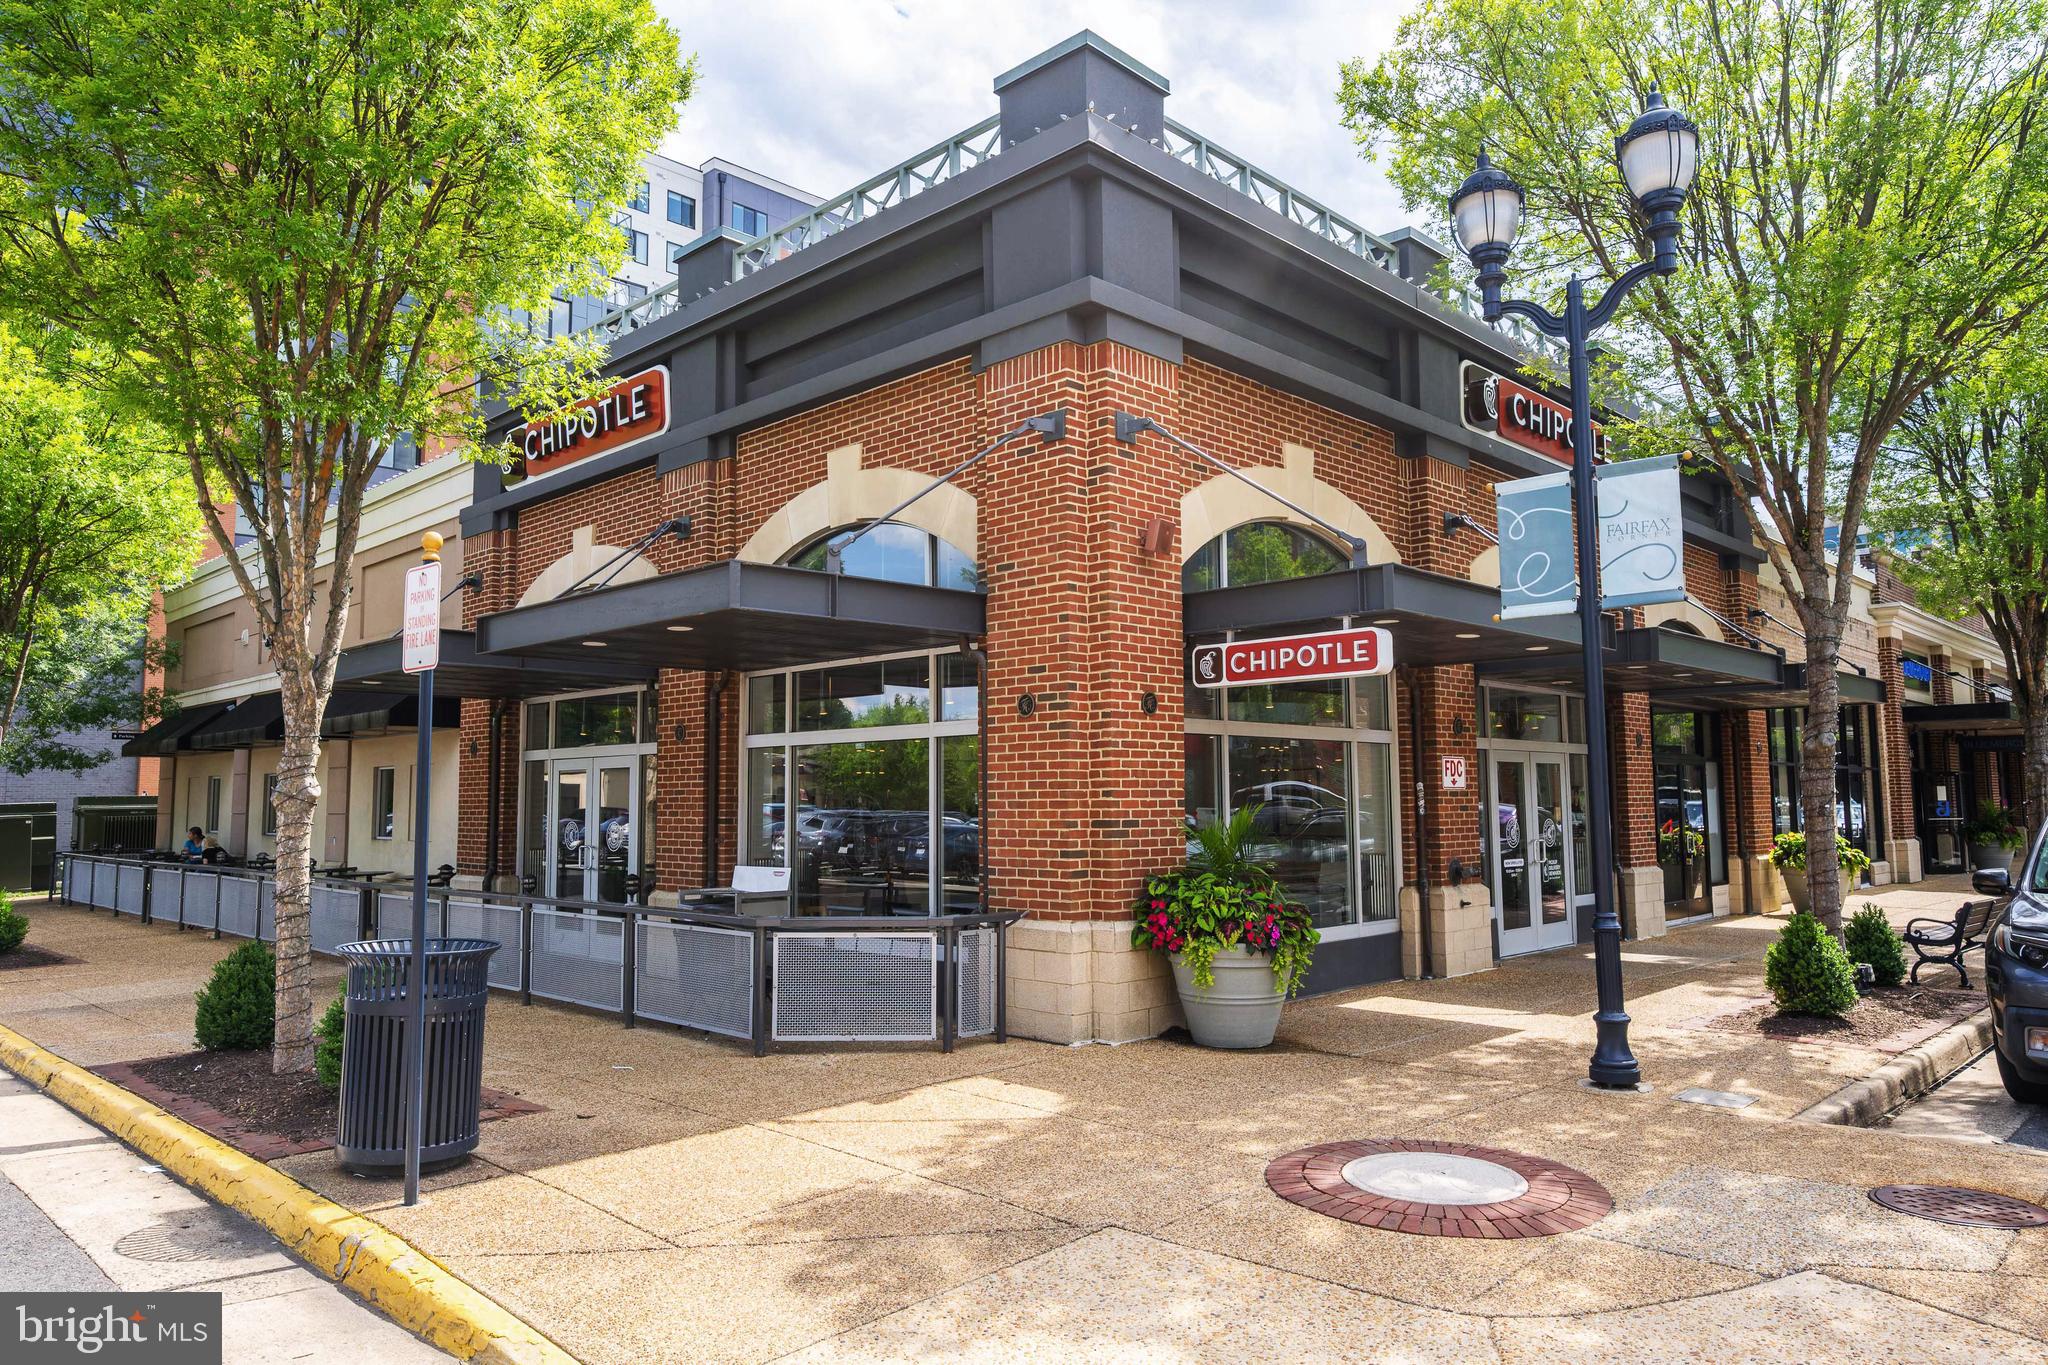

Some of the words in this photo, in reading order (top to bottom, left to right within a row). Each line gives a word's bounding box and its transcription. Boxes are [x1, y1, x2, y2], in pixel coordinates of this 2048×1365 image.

[525, 384, 646, 461] CHIPOTLE
[1607, 517, 1670, 537] FAIRFAX
[1606, 530, 1671, 544] CORNER
[410, 587, 435, 605] PARKING
[407, 613, 436, 630] STANDING
[406, 632, 419, 649] FIRE
[420, 629, 437, 647] LANE
[1231, 639, 1371, 674] CHIPOTLE
[1444, 760, 1463, 777] FDC
